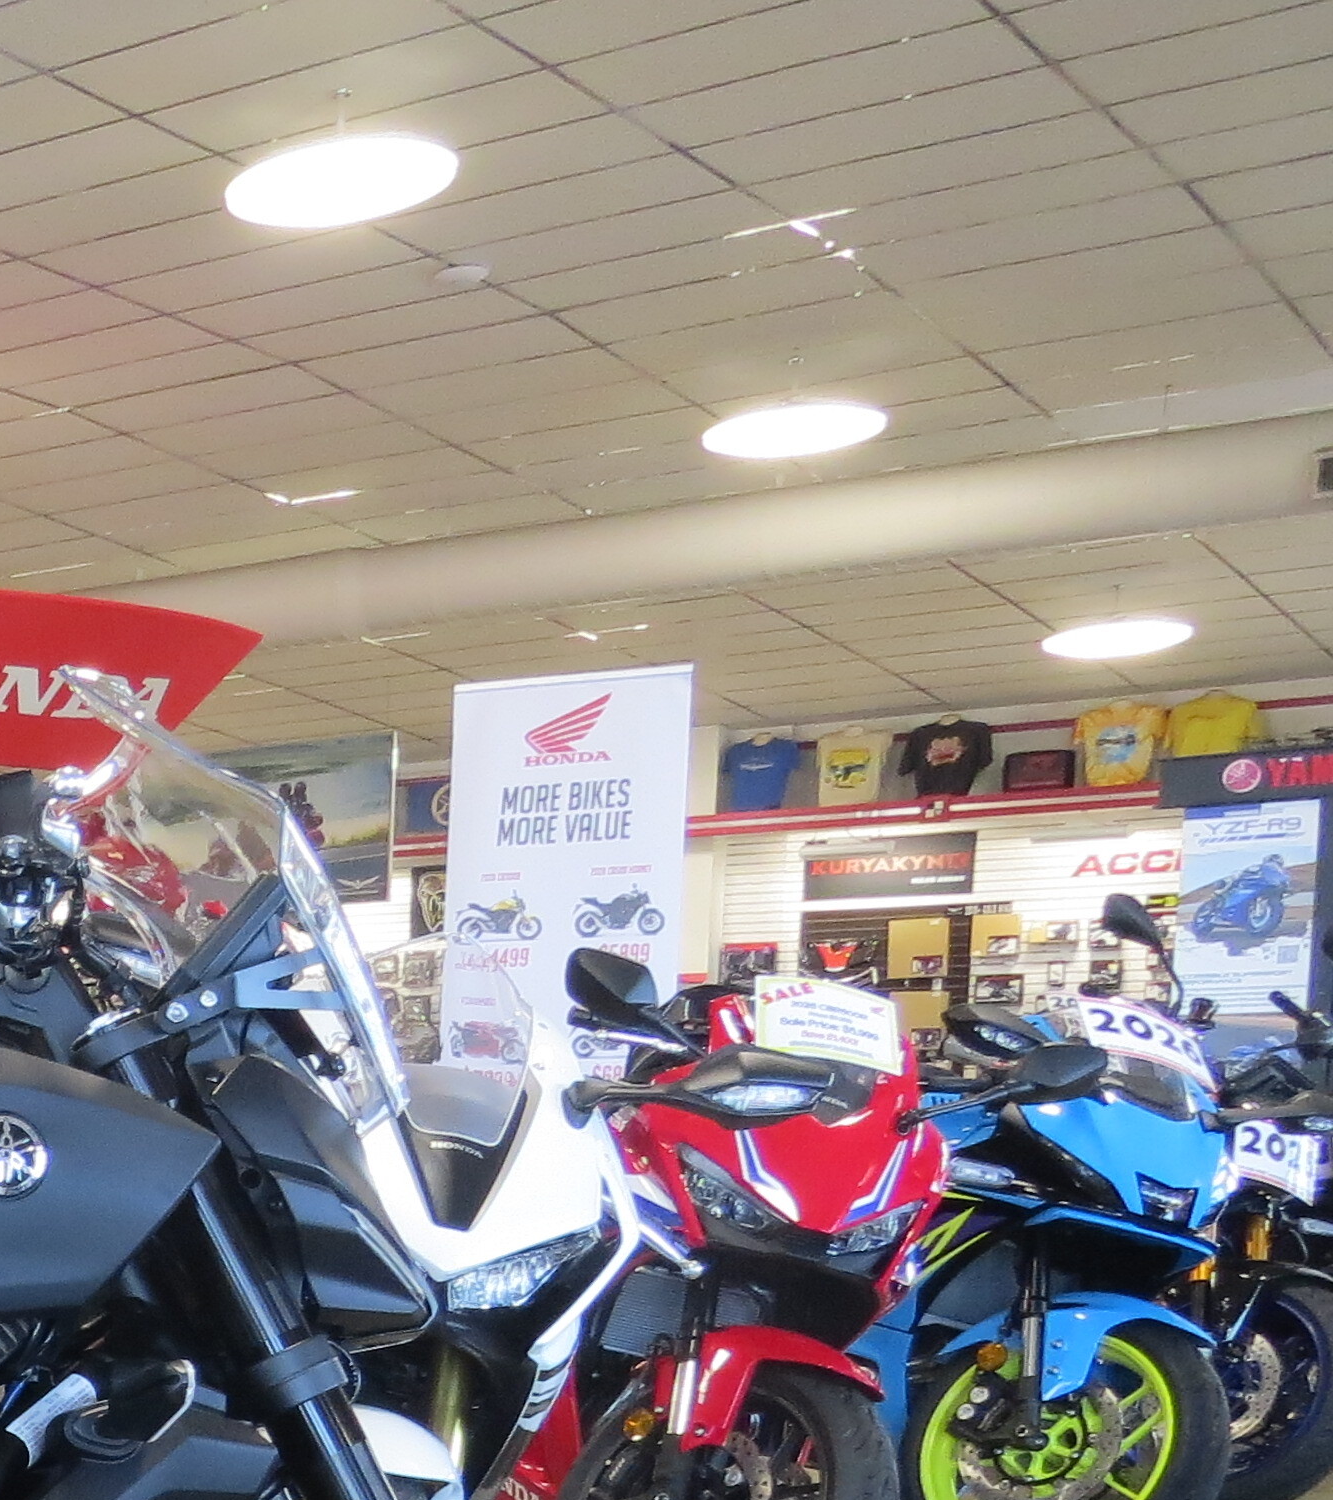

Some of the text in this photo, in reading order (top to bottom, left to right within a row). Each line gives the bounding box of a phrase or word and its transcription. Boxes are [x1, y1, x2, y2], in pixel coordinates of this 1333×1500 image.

[523, 750, 612, 767] HONDA
[501, 778, 631, 815] MORE BIKES
[497, 810, 632, 846] MORE VALUE
[1204, 817, 1301, 836] YZF-R9
[760, 982, 815, 1005] SALE
